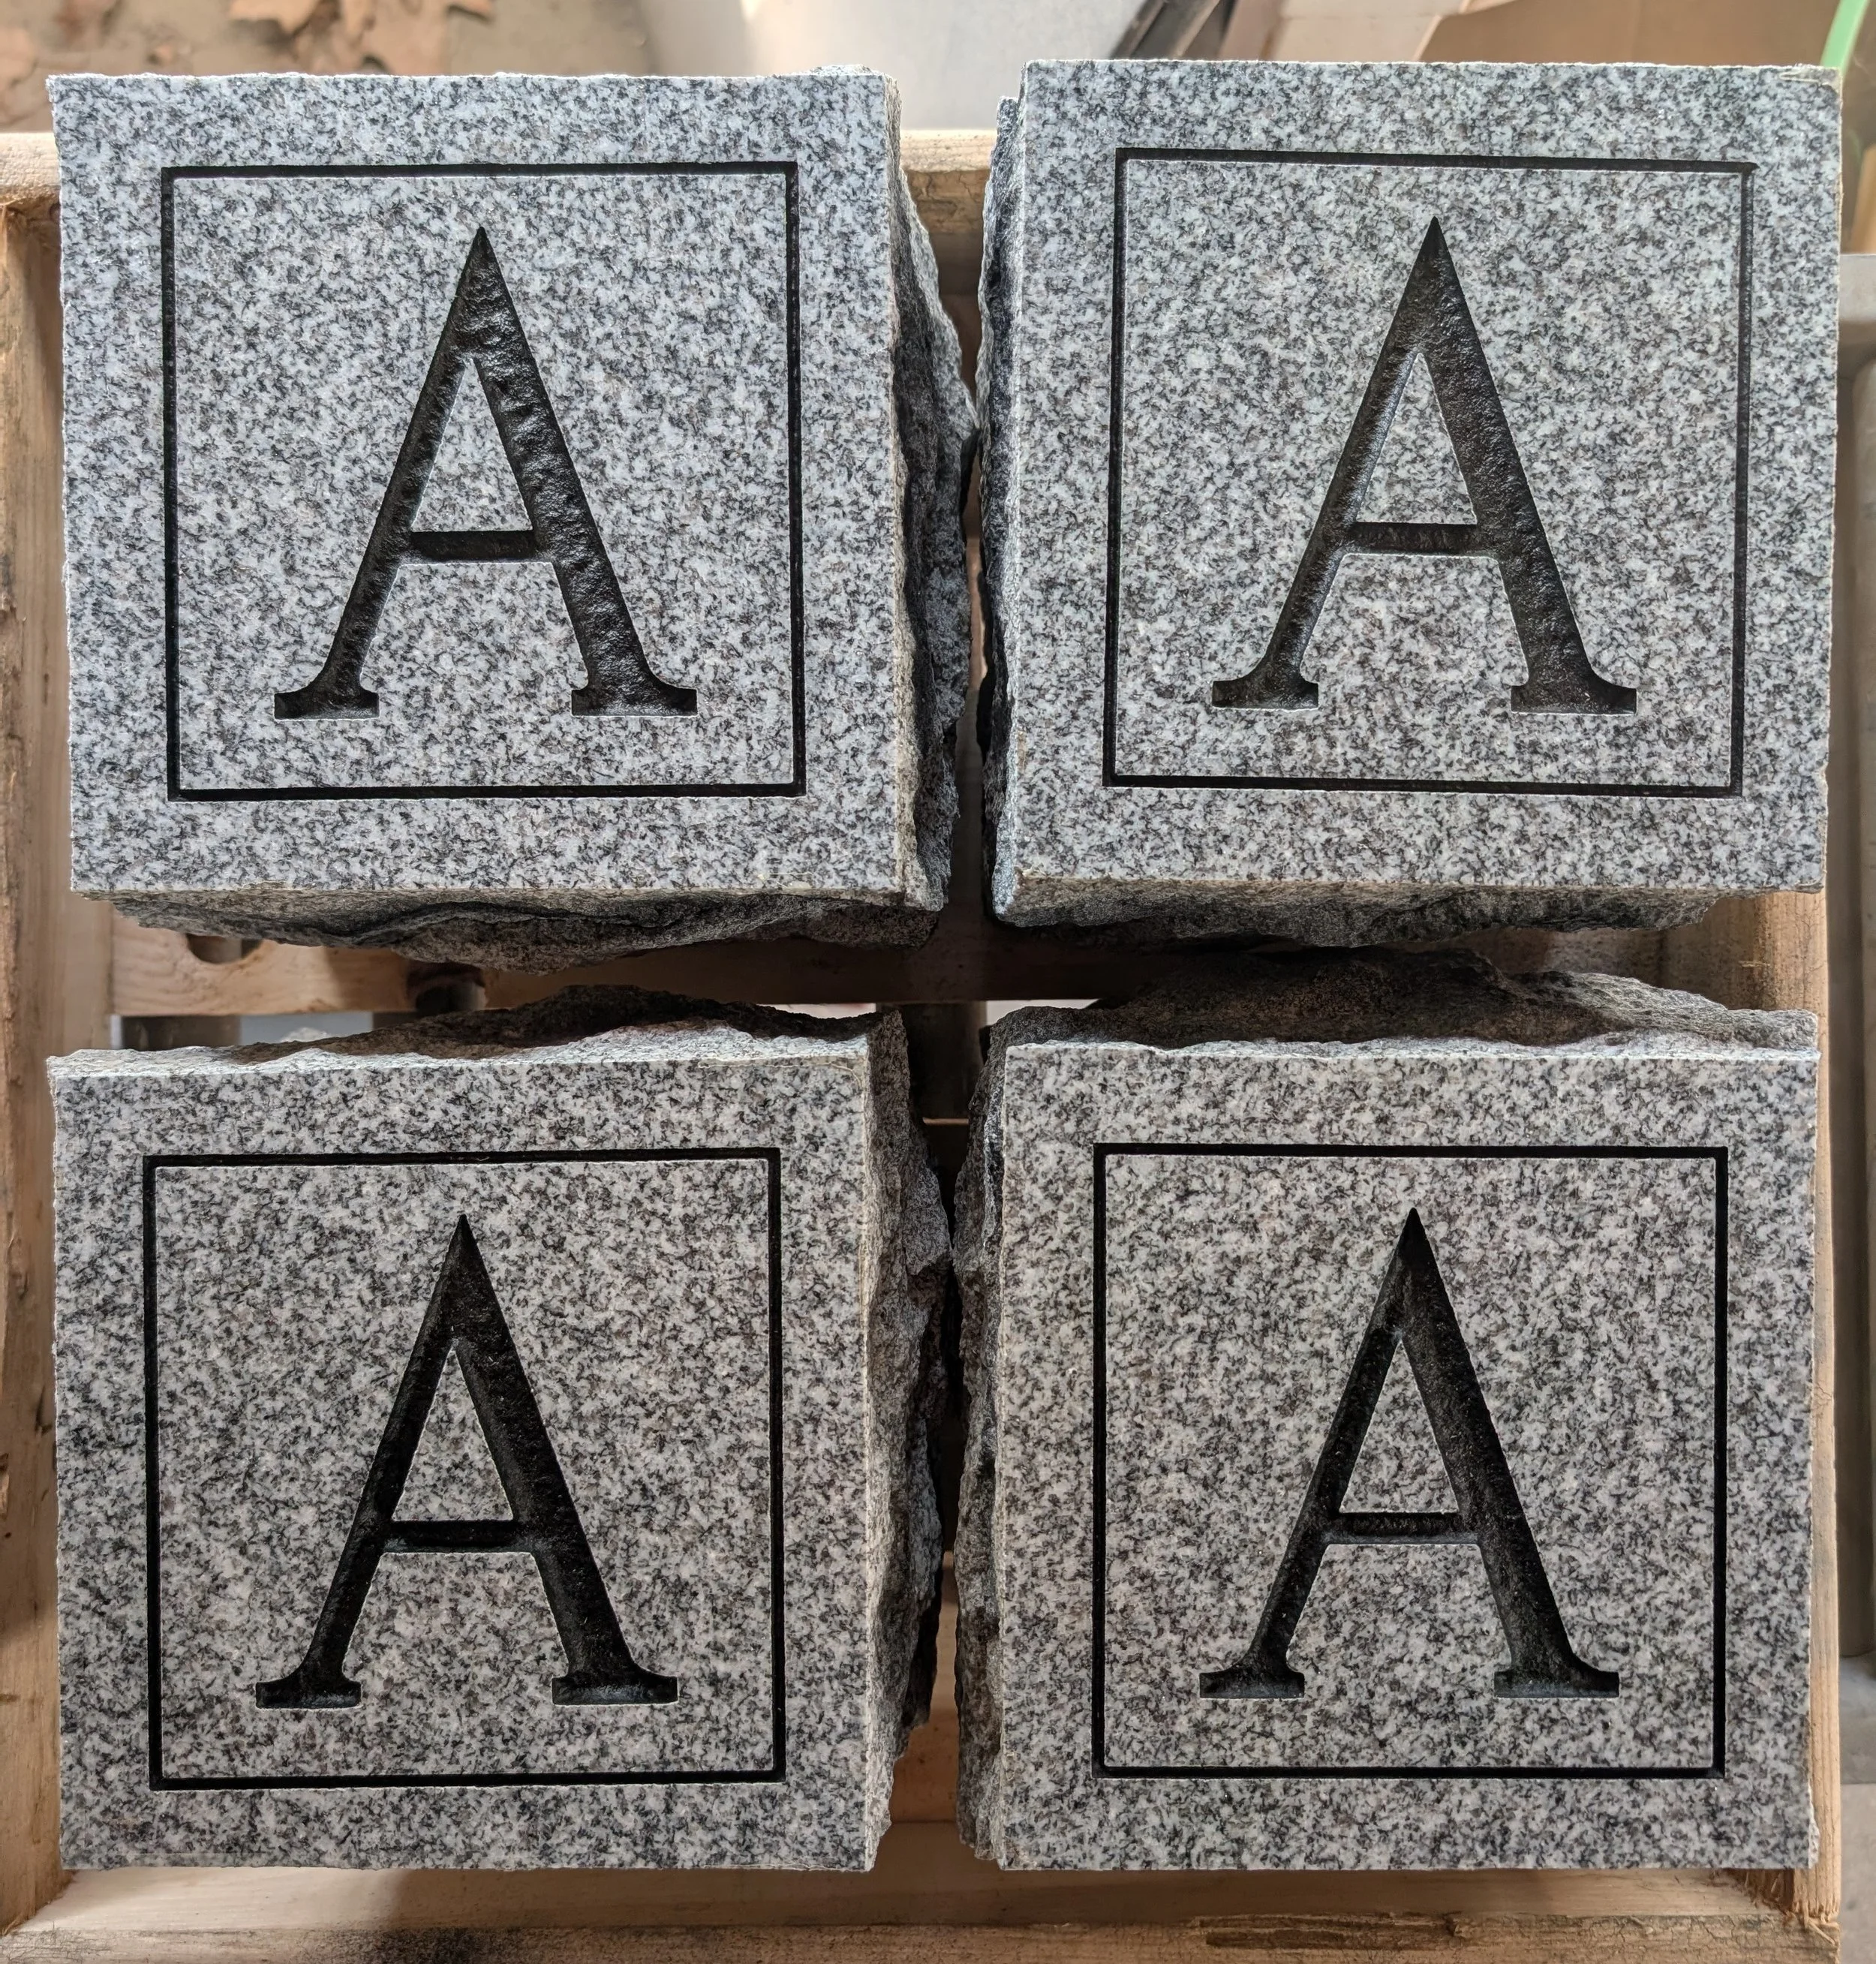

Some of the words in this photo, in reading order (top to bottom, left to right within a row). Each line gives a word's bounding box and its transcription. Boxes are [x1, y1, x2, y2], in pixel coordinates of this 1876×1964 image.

[276, 227, 696, 718] A
[1213, 218, 1636, 713] A
[254, 1213, 678, 1707] A
[1201, 1208, 1622, 1696] A
